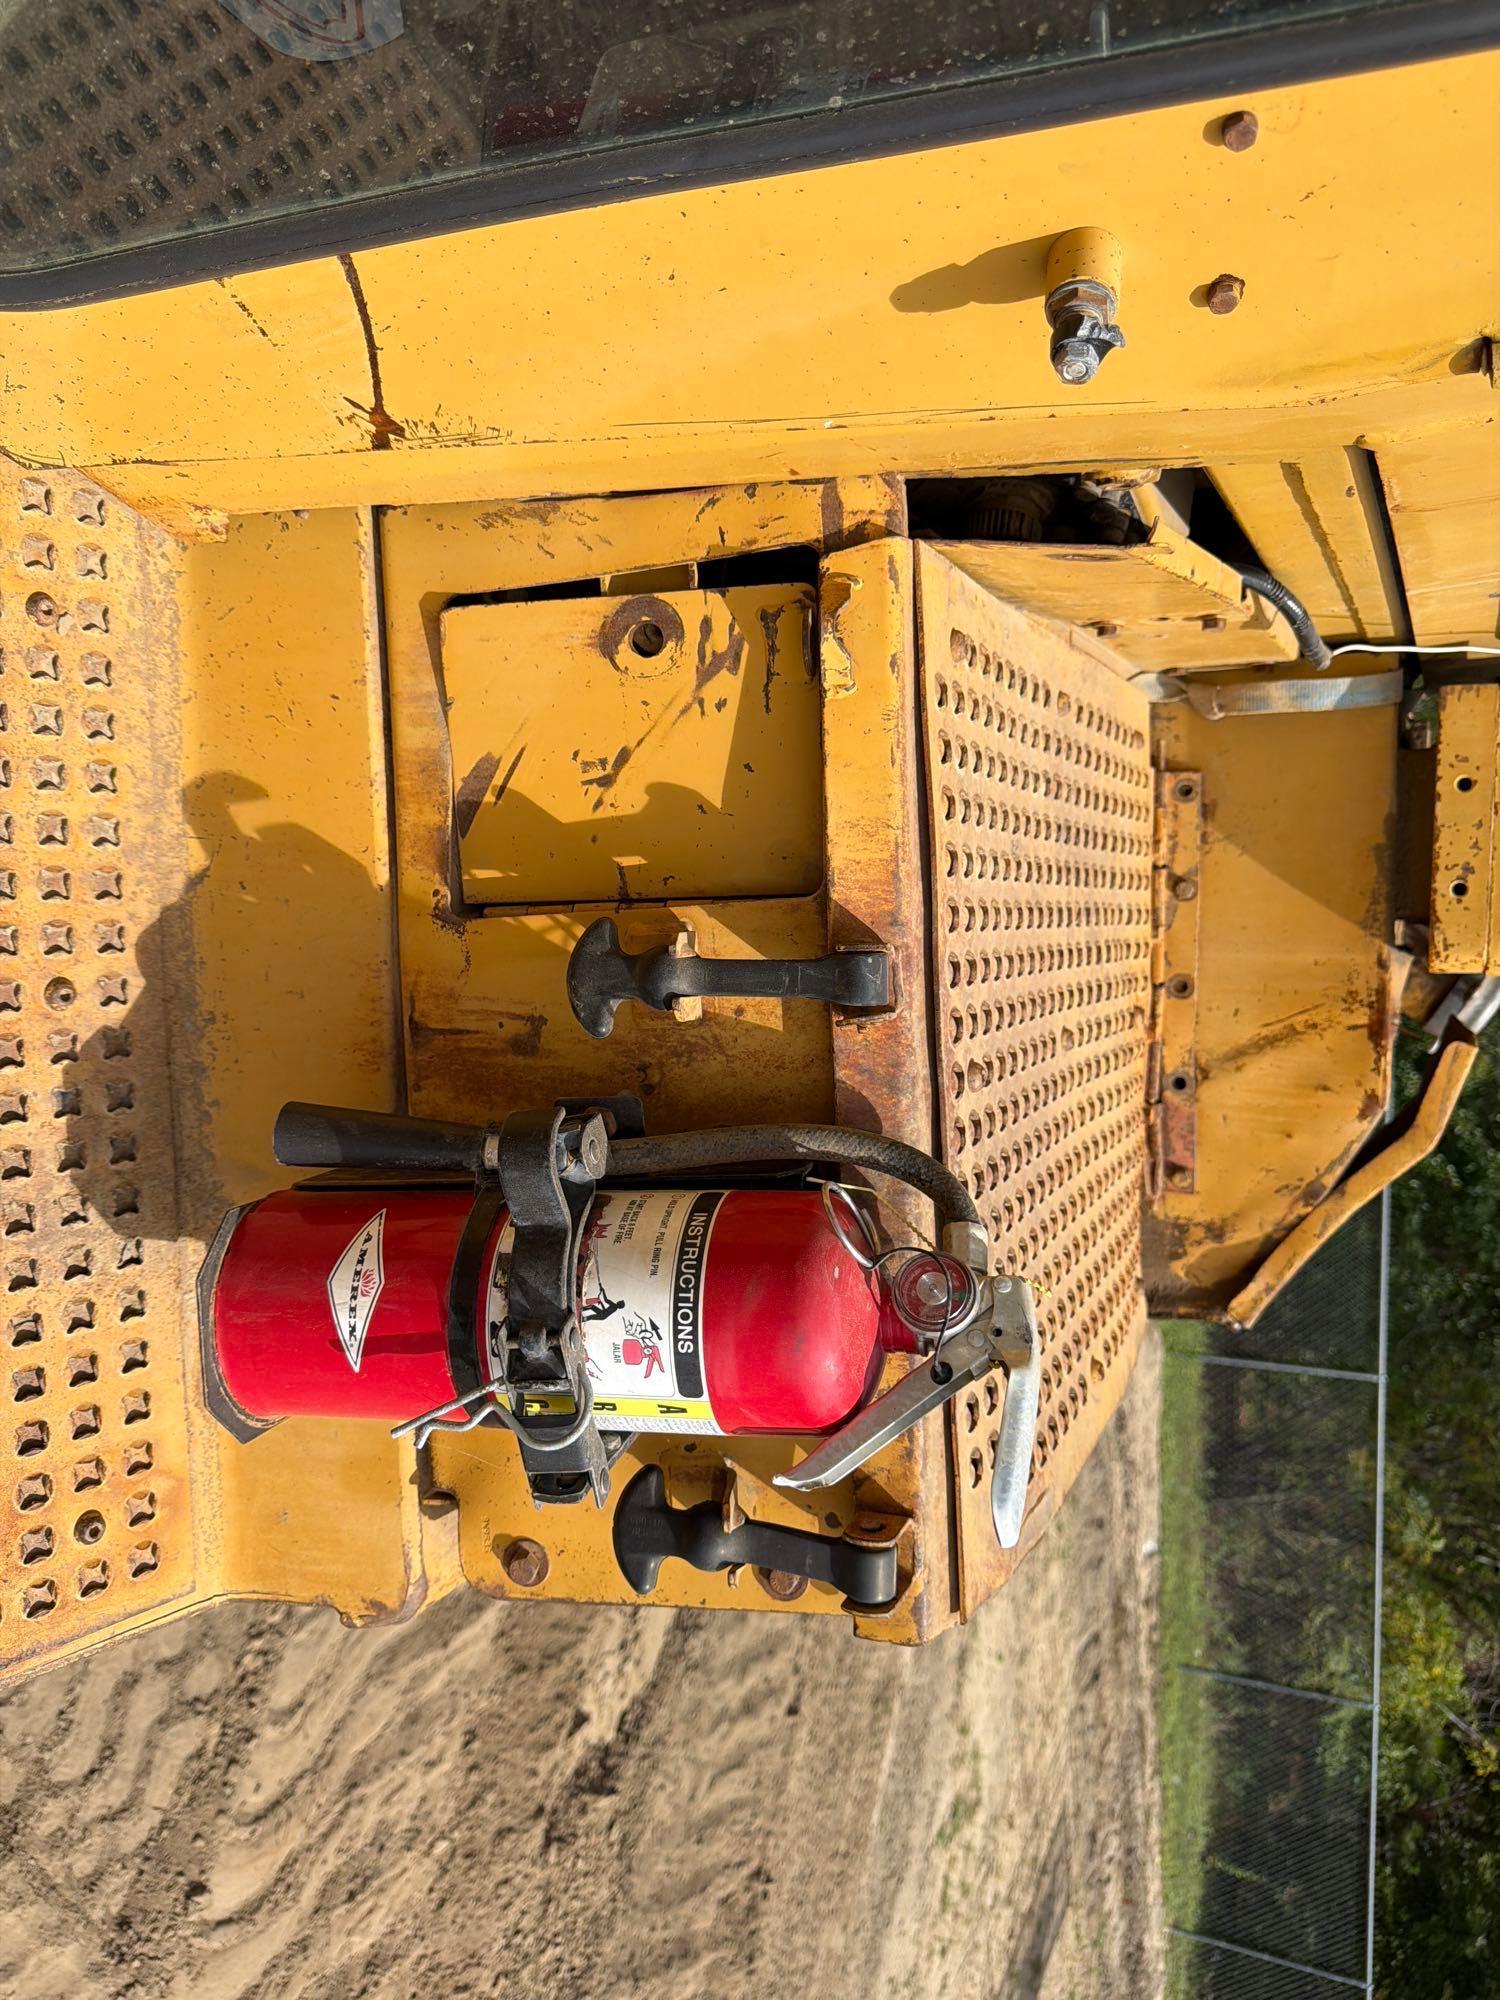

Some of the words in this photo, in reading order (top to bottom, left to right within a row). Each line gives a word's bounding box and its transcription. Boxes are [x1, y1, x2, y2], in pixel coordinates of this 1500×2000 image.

[636, 1200, 647, 1211] START
[667, 1200, 678, 1209] HOLD
[620, 1211, 631, 1223] BASE
[629, 1211, 640, 1223] BACK
[618, 1223, 627, 1231] OF
[623, 1227, 634, 1241] FEET.
[655, 1231, 665, 1246] PULL
[651, 1247, 662, 1263] RING
[649, 1264, 659, 1278] PIN.
[349, 1230, 373, 1343] AMEREX
[677, 1212, 708, 1354] INSTRUCTIONS
[612, 1341, 622, 1364] JALAR
[657, 1403, 688, 1415] A
